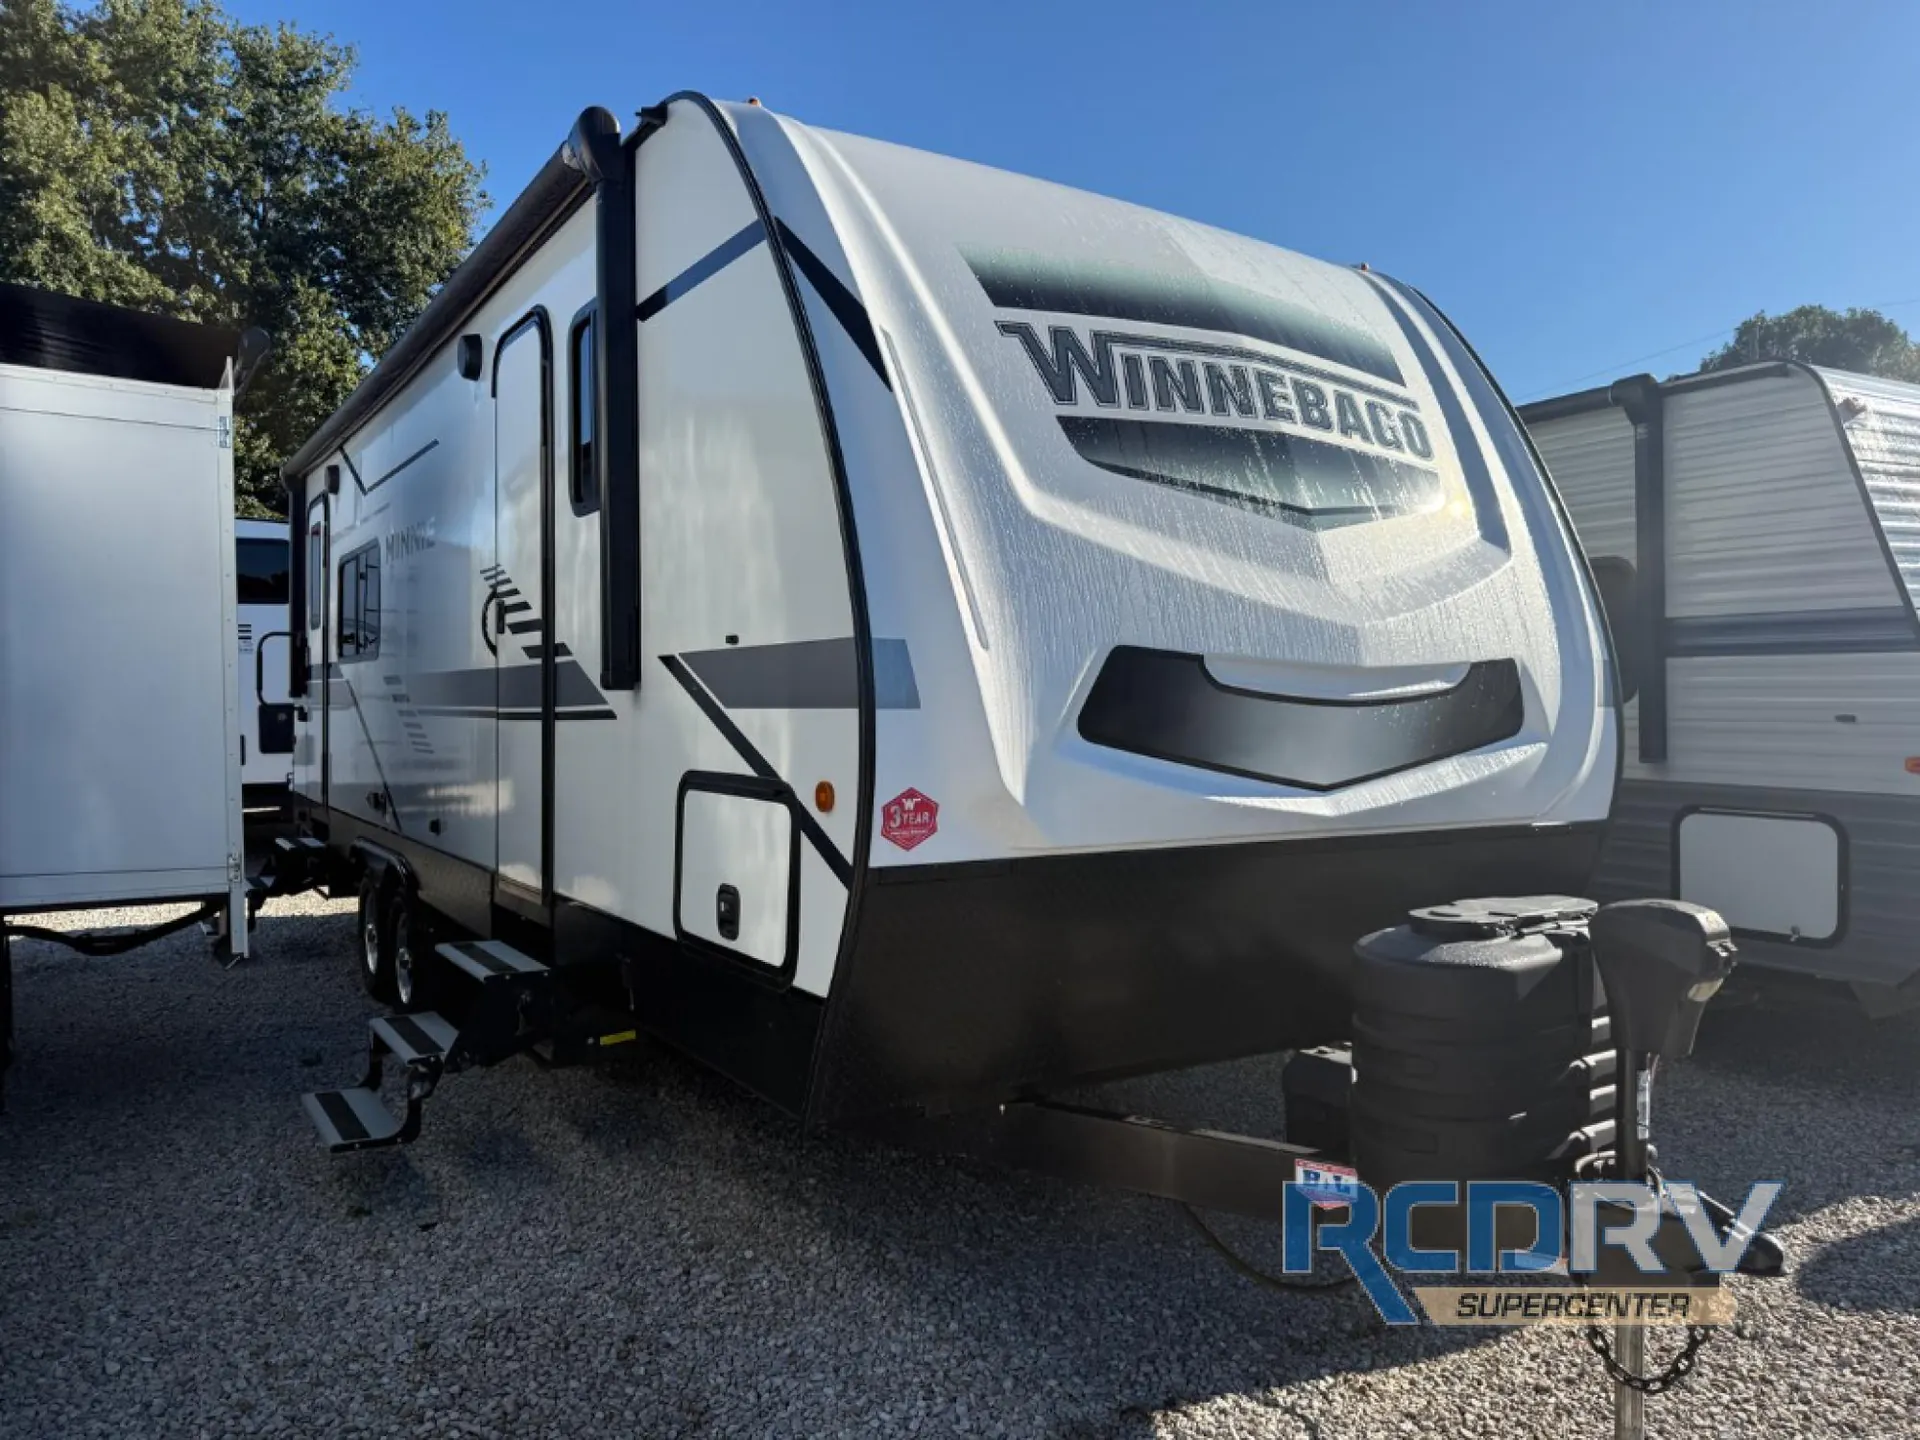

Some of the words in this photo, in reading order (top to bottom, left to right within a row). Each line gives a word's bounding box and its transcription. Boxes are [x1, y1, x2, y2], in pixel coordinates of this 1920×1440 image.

[994, 320, 1434, 460] WINNEBAGO
[890, 806, 901, 828] 3
[902, 811, 930, 825] YEAR
